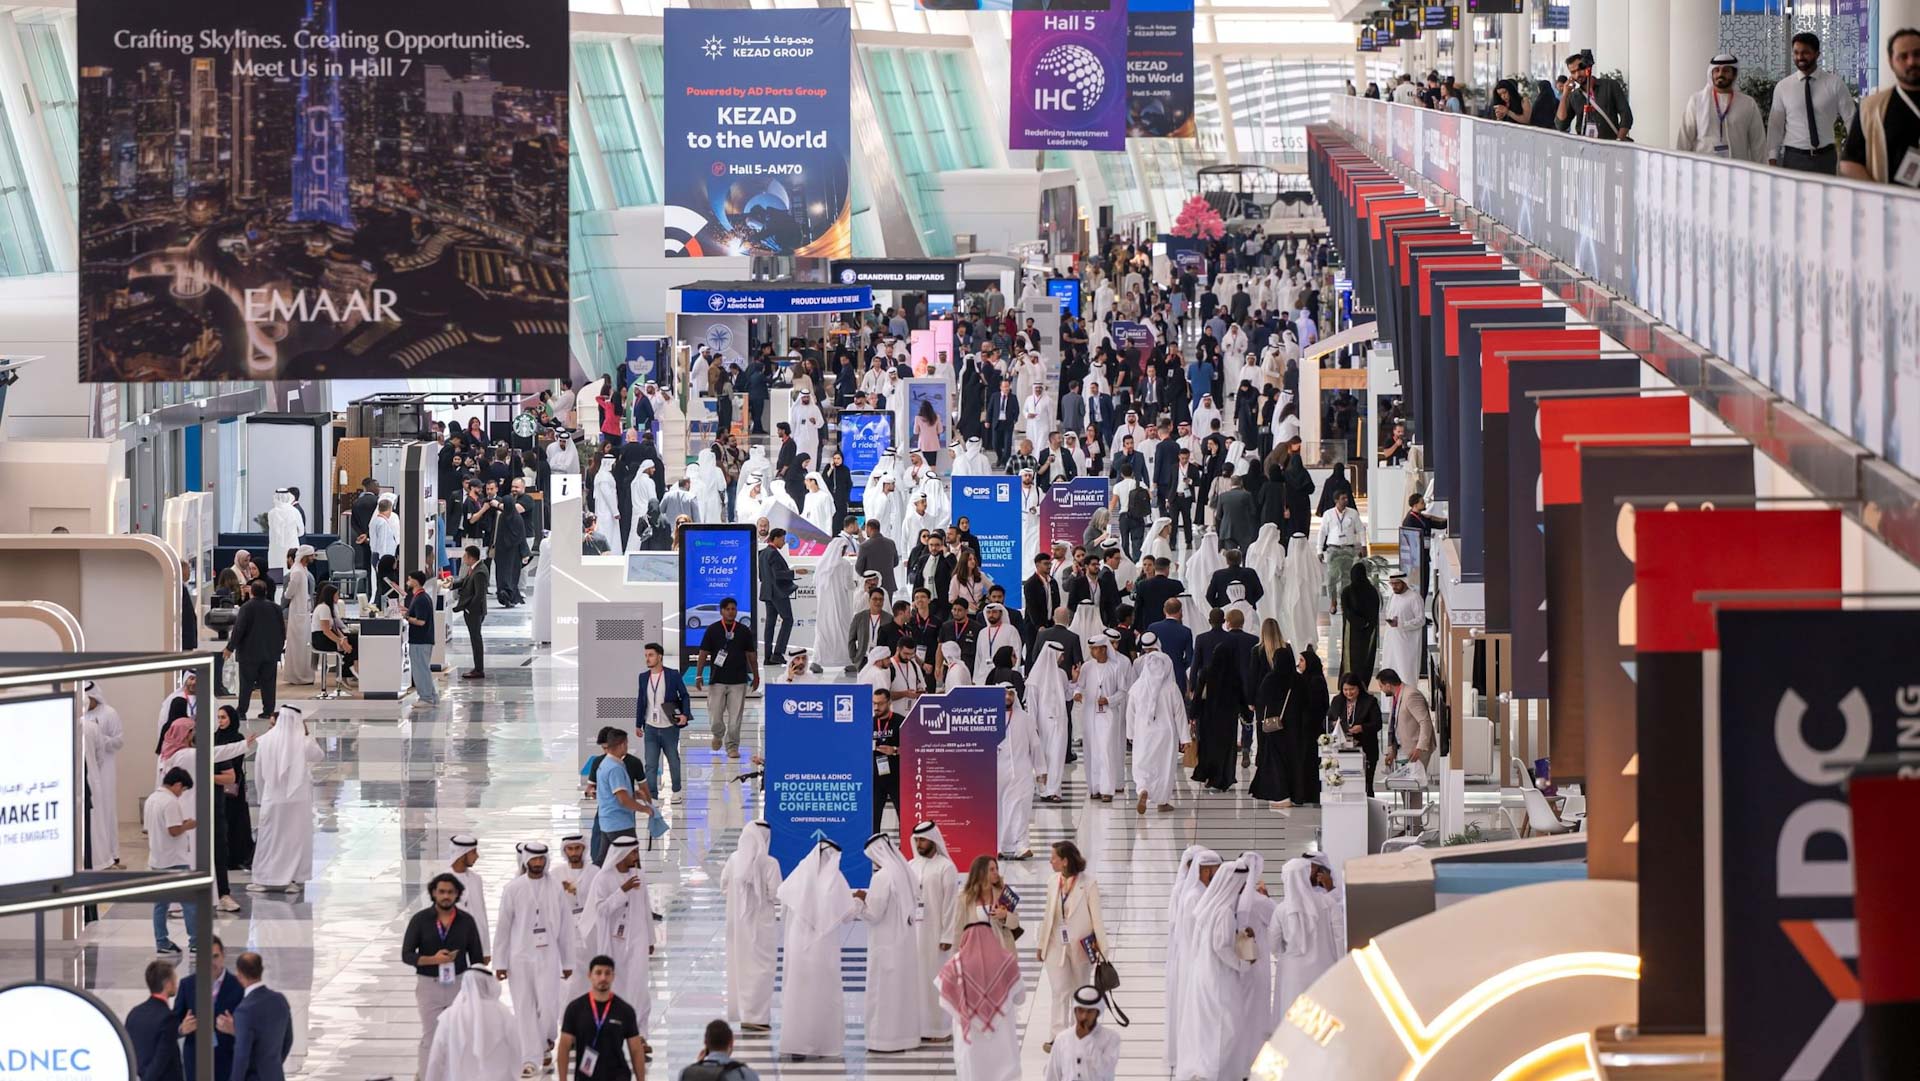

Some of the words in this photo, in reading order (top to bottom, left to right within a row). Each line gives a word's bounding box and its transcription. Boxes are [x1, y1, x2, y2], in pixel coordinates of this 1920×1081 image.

[1044, 15, 1079, 31] Hall
[1084, 16, 1096, 31] 5
[114, 29, 194, 55] Crafting
[199, 29, 287, 54] Skylines.
[293, 30, 379, 55] Creating
[385, 30, 530, 55] Opportunities.
[773, 35, 814, 46] مجموعة
[733, 48, 771, 58] KEZAD
[773, 48, 814, 58] GROUP
[232, 58, 285, 77] Meet
[290, 58, 318, 77] Us
[324, 58, 343, 77] in
[351, 57, 392, 77] Hall
[400, 59, 412, 77] 7
[1127, 61, 1168, 71] KEZAD
[1127, 73, 1146, 83] the
[1148, 73, 1184, 83] World
[686, 87, 732, 97] Powered
[733, 87, 746, 98] by
[747, 87, 763, 96] AD
[765, 87, 794, 96] Ports
[795, 87, 827, 98] Group
[1034, 88, 1077, 111] IHC
[717, 106, 797, 125] KEZAD
[1024, 129, 1065, 138] Redefining
[1066, 129, 1109, 138] Investment
[687, 131, 712, 149] to
[716, 130, 754, 149] the
[758, 130, 828, 149] World
[1047, 138, 1088, 147] Leadership
[729, 164, 753, 175] Hall
[754, 164, 803, 175] 5-AM70
[857, 273, 903, 281] GRANDWELD
[905, 273, 945, 281] SHIPYARDS
[244, 288, 403, 323] EMAAR
[791, 297, 821, 305] PROUDLY
[821, 296, 837, 304] MADE
[973, 487, 990, 495] CIPS
[1074, 494, 1096, 502] MAKE
[1097, 494, 1105, 502] IT
[979, 540, 1016, 548] UREMENT
[701, 556, 719, 564] 15%
[721, 556, 737, 564] off
[699, 566, 706, 574] 6
[556, 616, 579, 625] INFO
[797, 701, 824, 712] CIPS
[951, 715, 985, 725] MAKE
[986, 715, 998, 725] IT
[784, 773, 801, 781] CIPS
[801, 773, 820, 781] MENA
[821, 773, 827, 781] &
[827, 773, 852, 781] ADNOC
[773, 782, 863, 792] PROCUREMENT
[780, 792, 856, 801] EXCELLENCE
[45, 800, 59, 820] IT
[779, 802, 858, 812] CONFERENCE
[20, 828, 60, 844] EMIRATES
